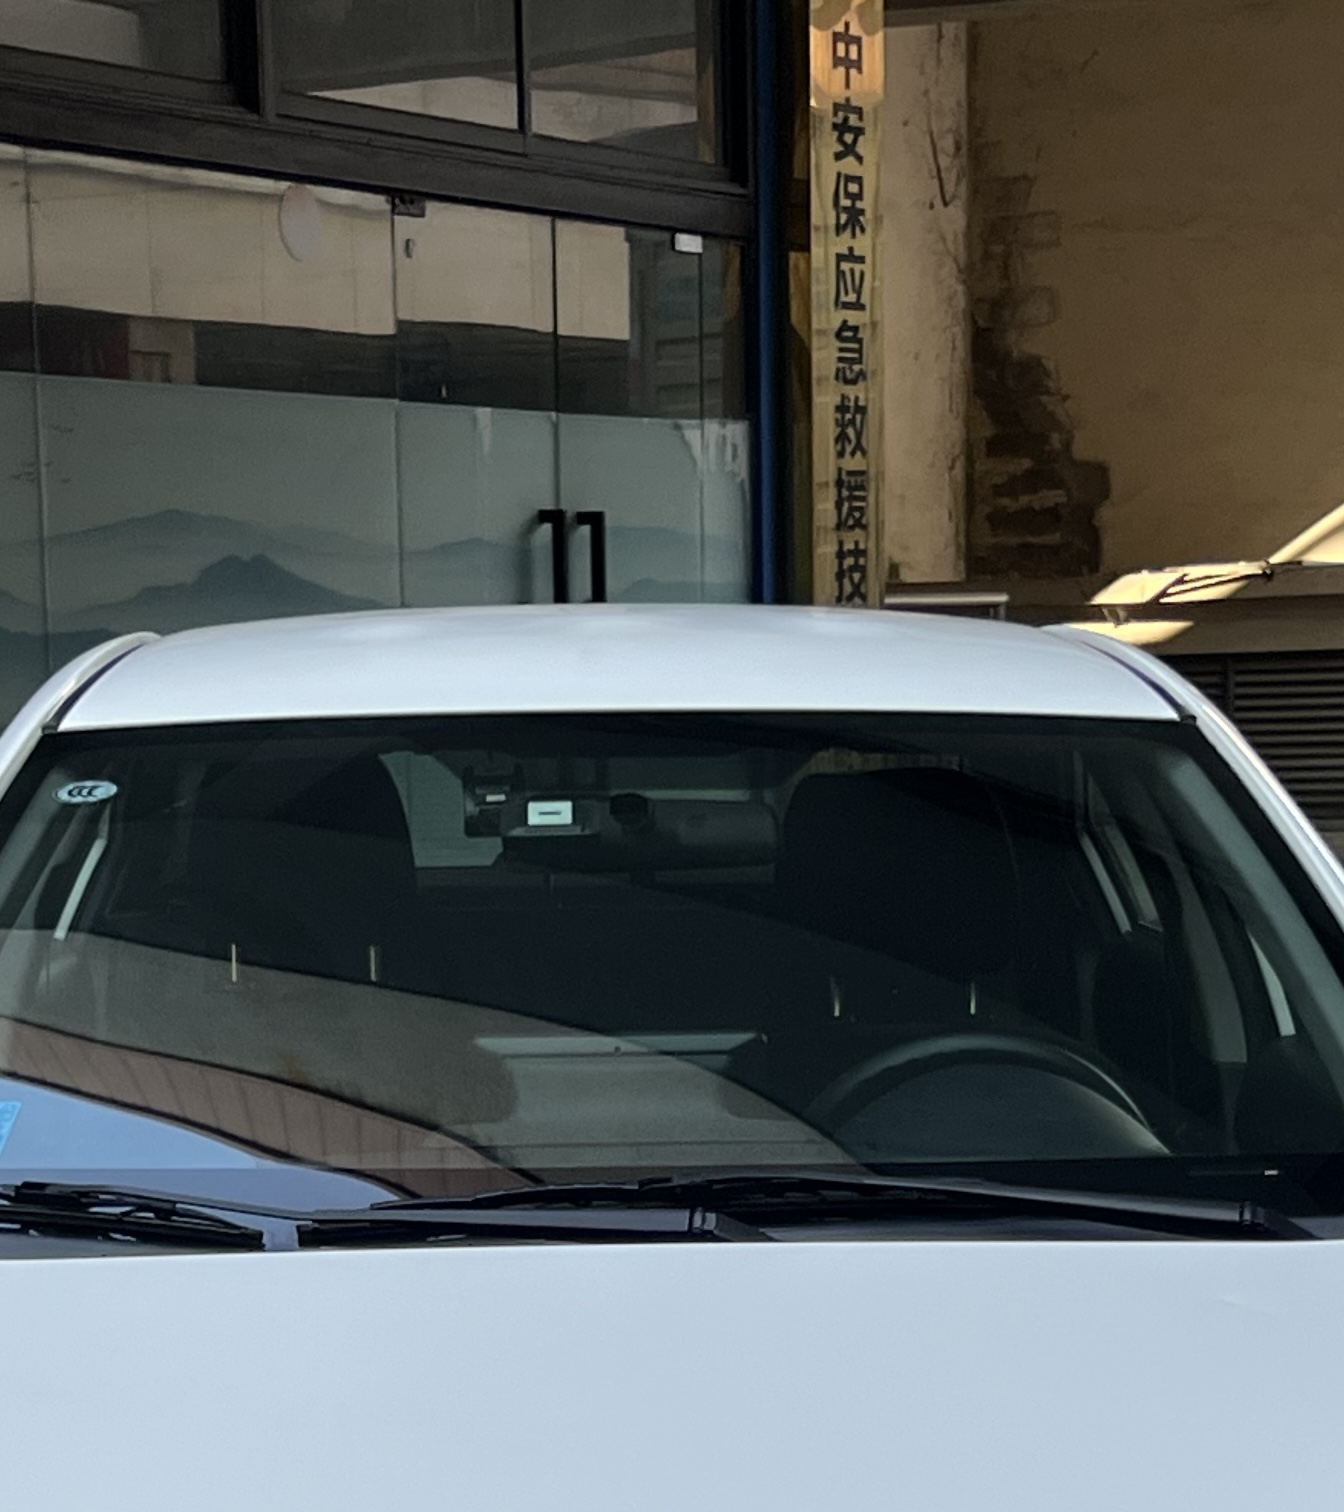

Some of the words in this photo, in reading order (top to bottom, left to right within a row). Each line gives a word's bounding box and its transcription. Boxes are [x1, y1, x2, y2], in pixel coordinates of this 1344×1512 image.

[831, 20, 869, 604] 中安保应急救援技
